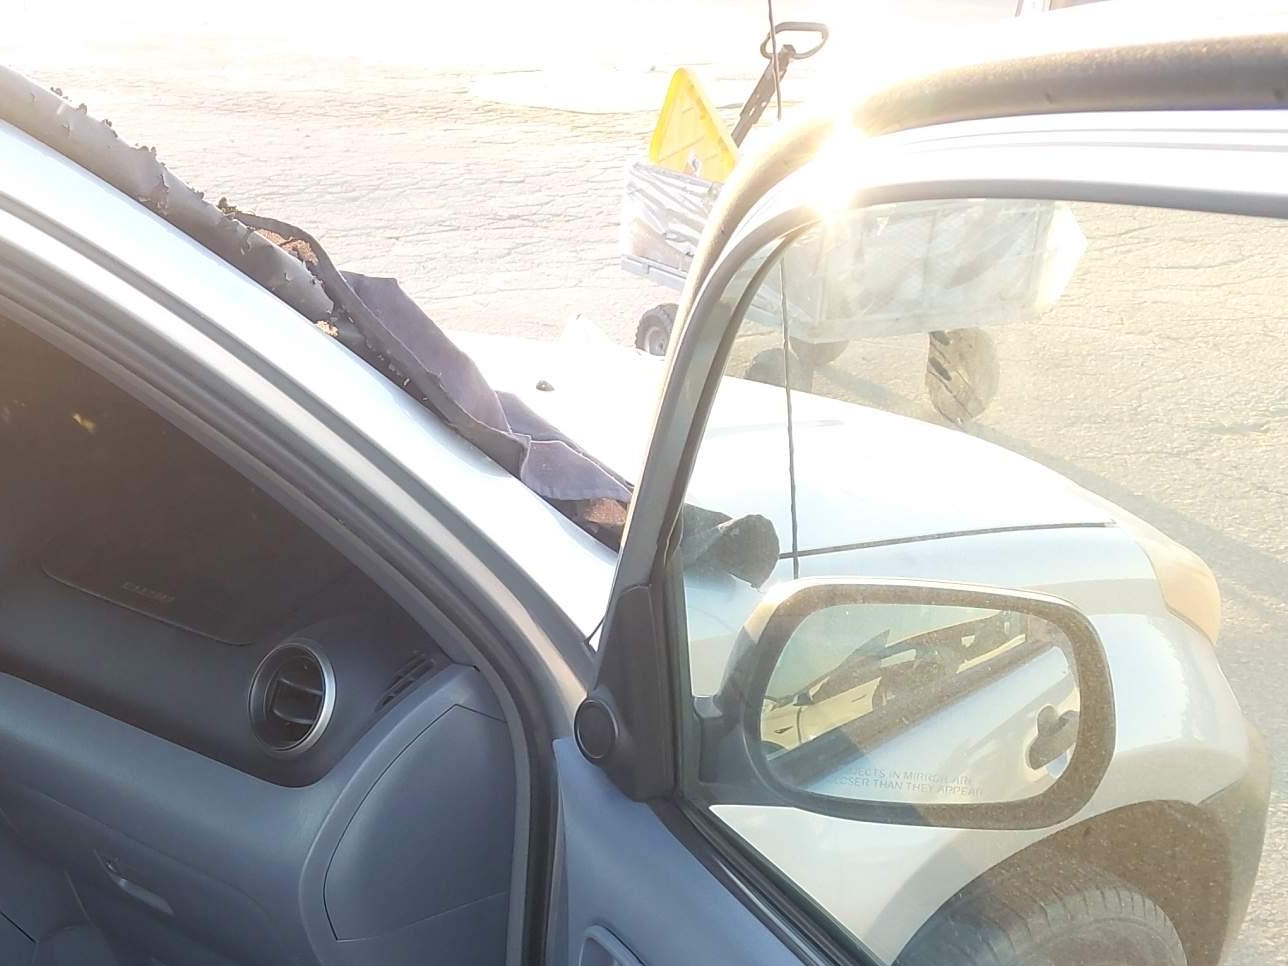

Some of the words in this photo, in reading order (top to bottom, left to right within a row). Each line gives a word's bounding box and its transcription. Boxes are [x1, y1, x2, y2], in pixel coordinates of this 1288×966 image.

[843, 766, 885, 779] JECTS
[831, 774, 871, 787] LOSER
[872, 778, 904, 791] THAN
